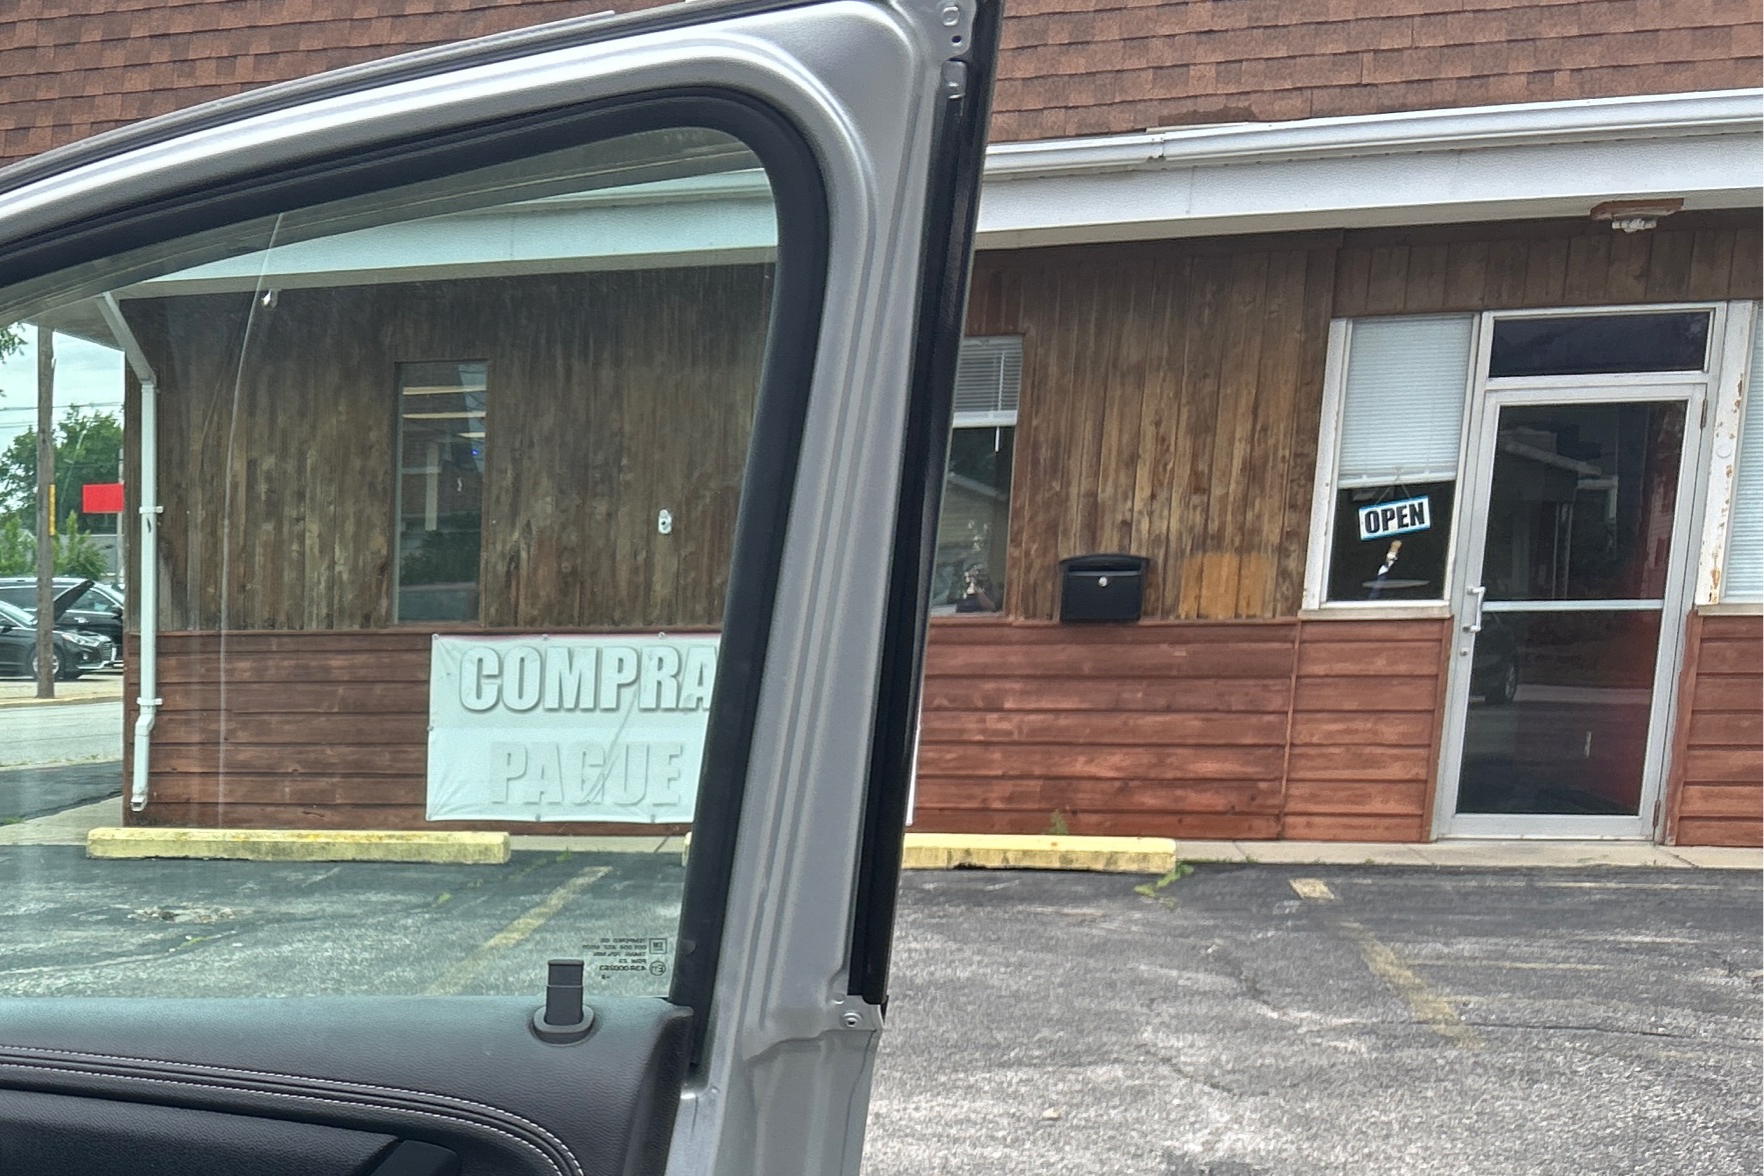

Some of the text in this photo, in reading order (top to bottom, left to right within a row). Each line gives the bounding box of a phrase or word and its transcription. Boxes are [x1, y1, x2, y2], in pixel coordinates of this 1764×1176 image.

[1364, 501, 1425, 534] OPEN
[459, 646, 717, 712] COMPRA
[490, 741, 683, 806] PAGUE
